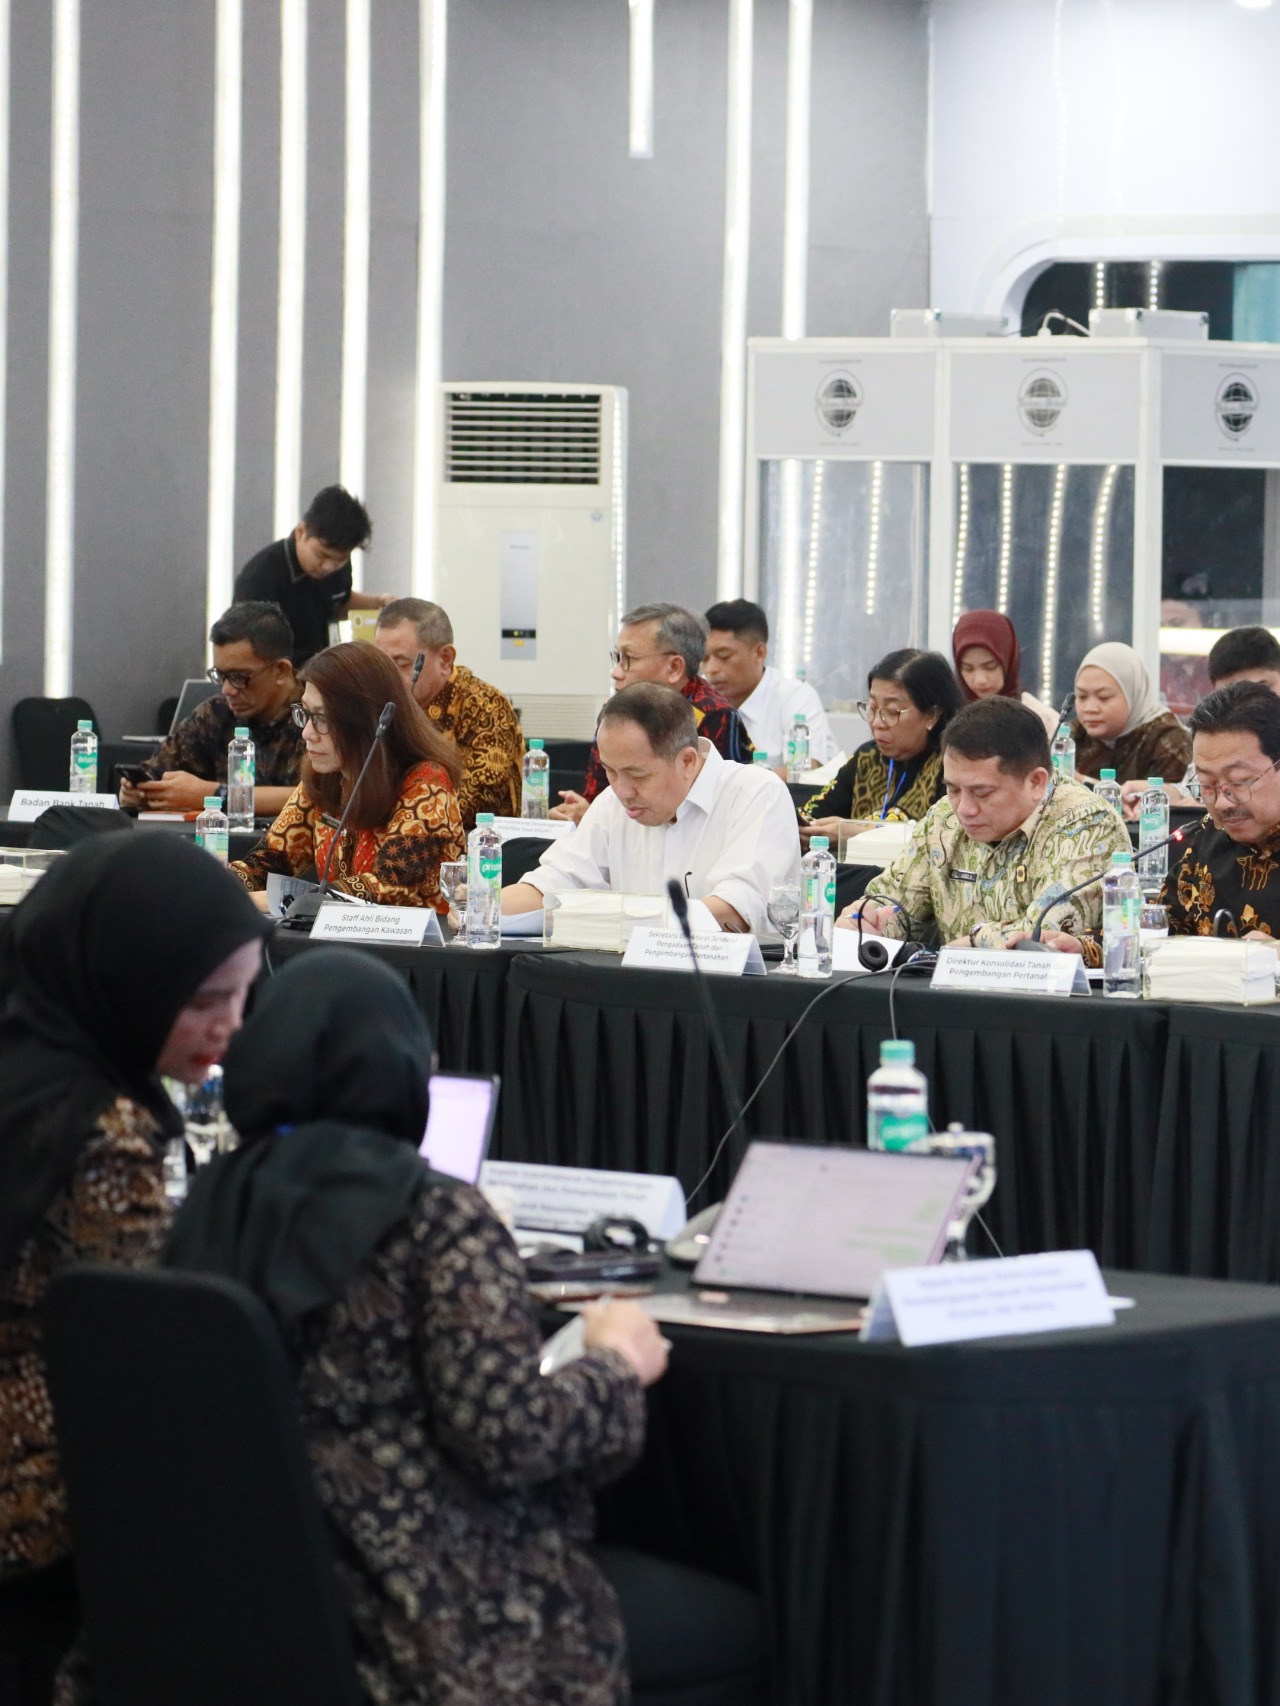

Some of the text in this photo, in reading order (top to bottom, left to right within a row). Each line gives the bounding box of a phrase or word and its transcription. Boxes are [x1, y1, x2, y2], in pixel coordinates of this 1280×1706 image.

[20, 798, 50, 806] Badan
[52, 799, 76, 807] Bank
[341, 914, 401, 924] Staff Ahli Bidang
[324, 924, 413, 935] Pengembangan Kawasan
[648, 930, 678, 940] Sekretaris
[656, 940, 691, 949] Pengadaan
[645, 948, 729, 961] Pengembangan Pertanahan
[946, 957, 980, 966] Direktur
[980, 958, 1026, 969] Konsolidasi
[1027, 961, 1052, 970] Tanah
[949, 967, 1012, 980] Pengembangan
